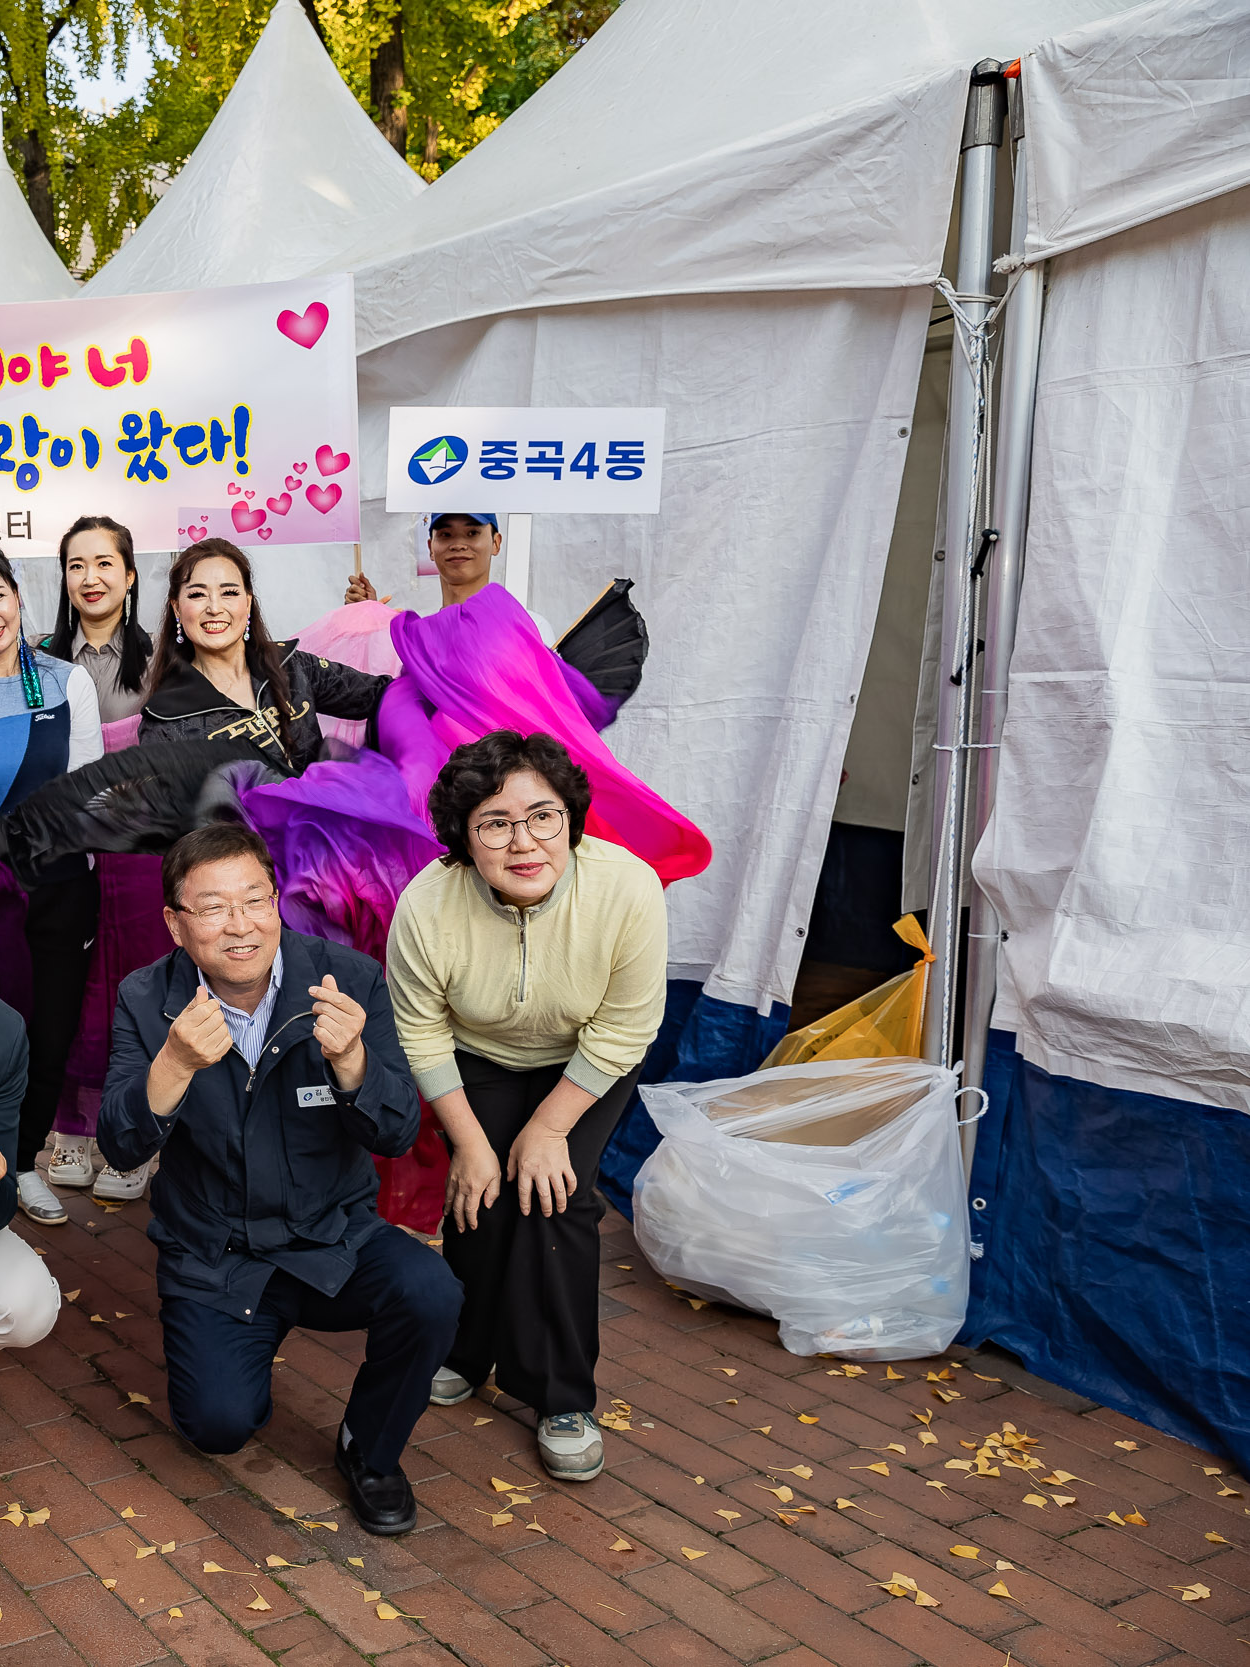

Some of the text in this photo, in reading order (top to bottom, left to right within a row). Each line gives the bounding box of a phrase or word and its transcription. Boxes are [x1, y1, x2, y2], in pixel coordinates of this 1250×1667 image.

[85, 336, 152, 391] 너
[115, 403, 254, 485] 왔다!
[479, 440, 646, 481] 중곡4동
